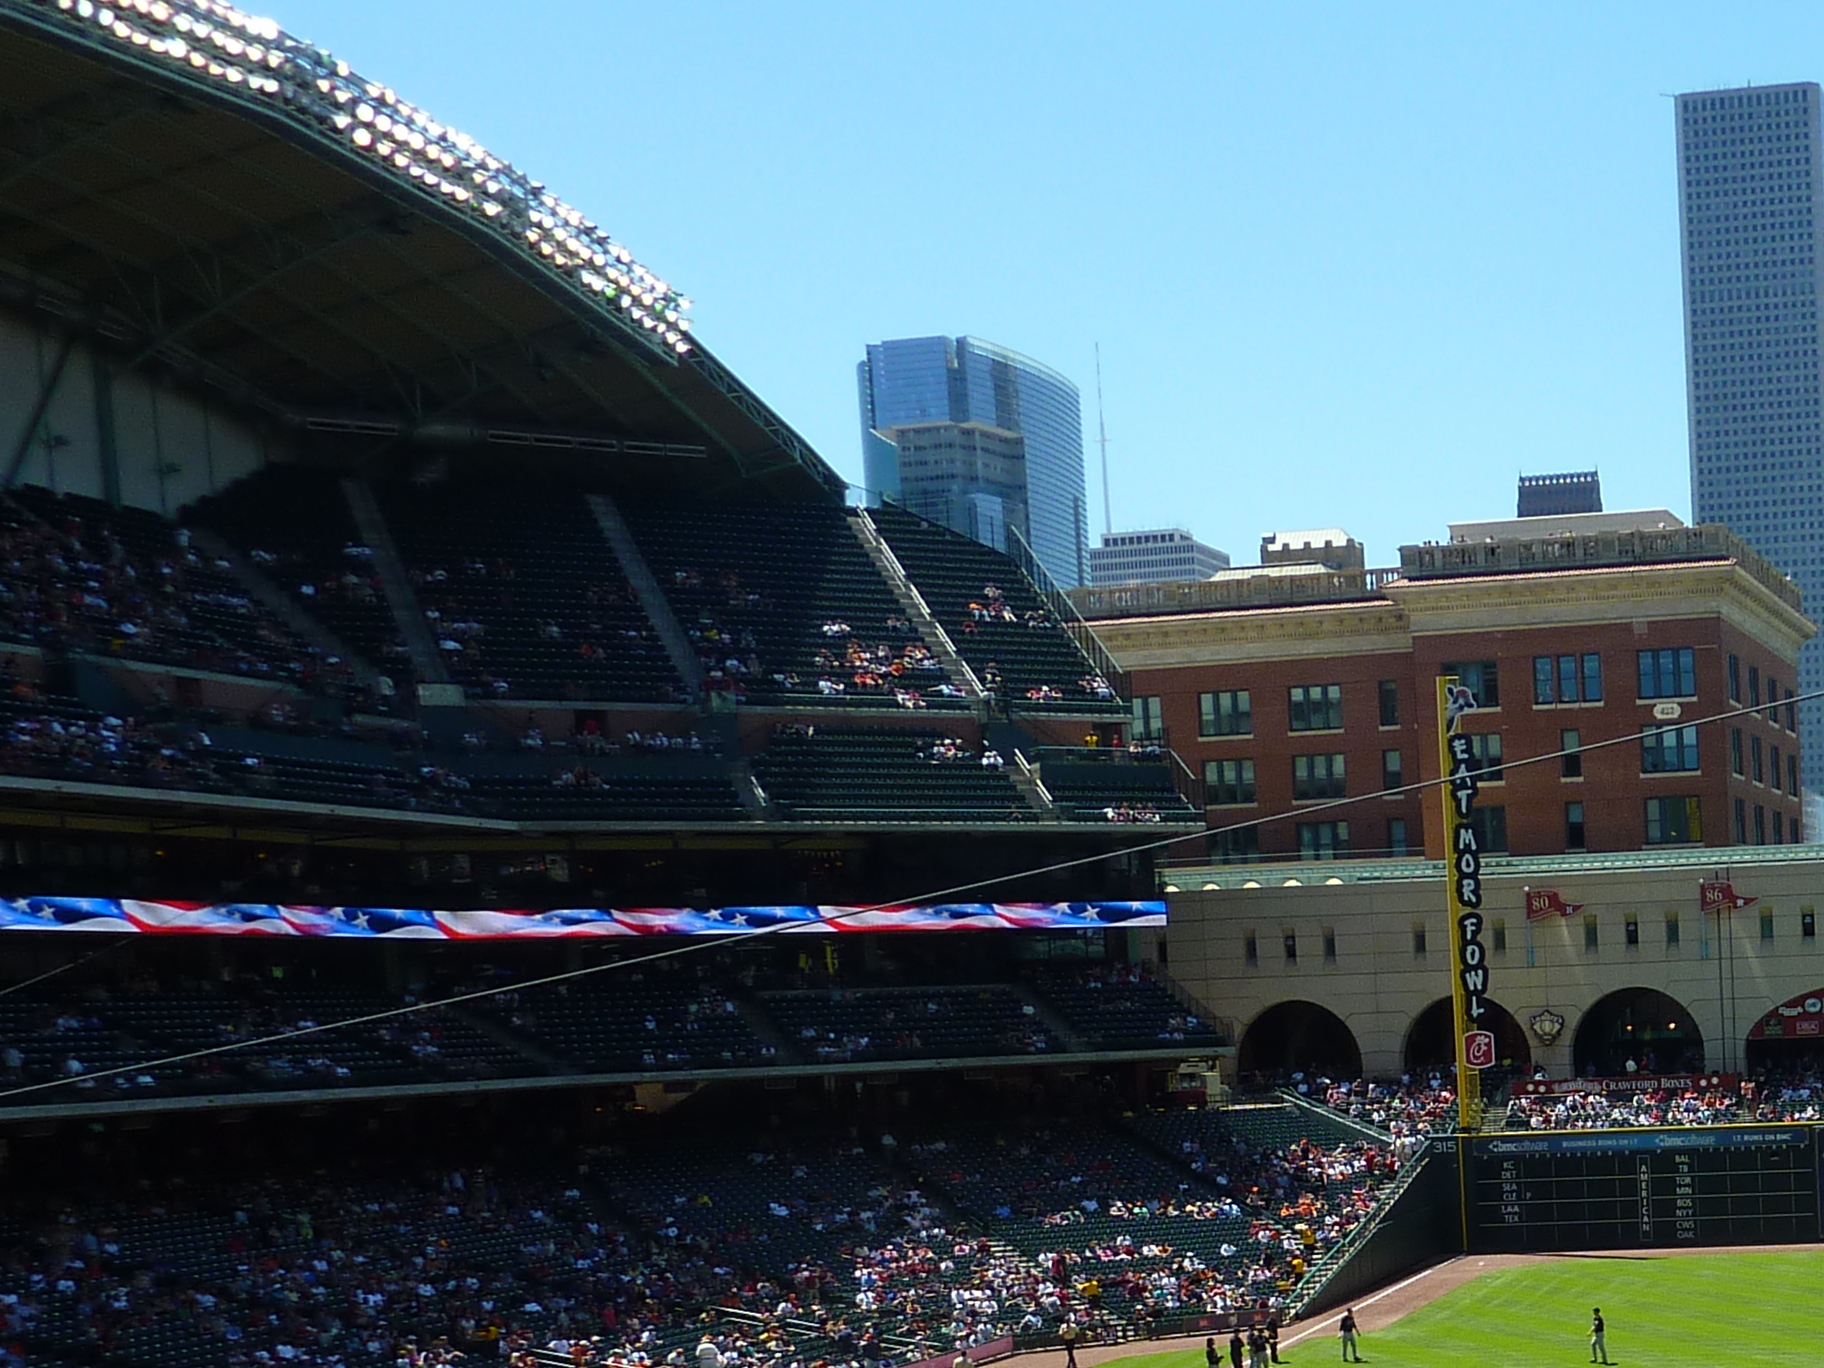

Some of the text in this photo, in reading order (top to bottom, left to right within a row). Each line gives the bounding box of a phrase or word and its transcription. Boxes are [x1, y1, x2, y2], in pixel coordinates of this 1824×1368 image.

[1453, 737, 1485, 1019] EAT MOR FOWL
[1706, 888, 1723, 903] 86
[1532, 896, 1549, 911] 80
[1602, 1079, 1658, 1091] CRAWFORD
[1660, 1077, 1693, 1089] BOXES
[1433, 1141, 1457, 1153] 315
[1674, 1154, 1690, 1164] BAL
[1503, 1160, 1515, 1170] KC
[1678, 1164, 1689, 1173] TB
[1501, 1170, 1517, 1180] DET
[1675, 1176, 1692, 1186] TOR
[1502, 1182, 1518, 1192] SEA
[1676, 1186, 1693, 1195] MIN
[1503, 1192, 1518, 1201] CLE
[1640, 1164, 1650, 1232] AMERICAN
[1676, 1198, 1693, 1207] BOS
[1501, 1204, 1520, 1214] LAA
[1676, 1208, 1694, 1217] NYY
[1504, 1213, 1520, 1223] TEX
[1676, 1220, 1695, 1230] CWS
[1676, 1229, 1696, 1239] OAK
